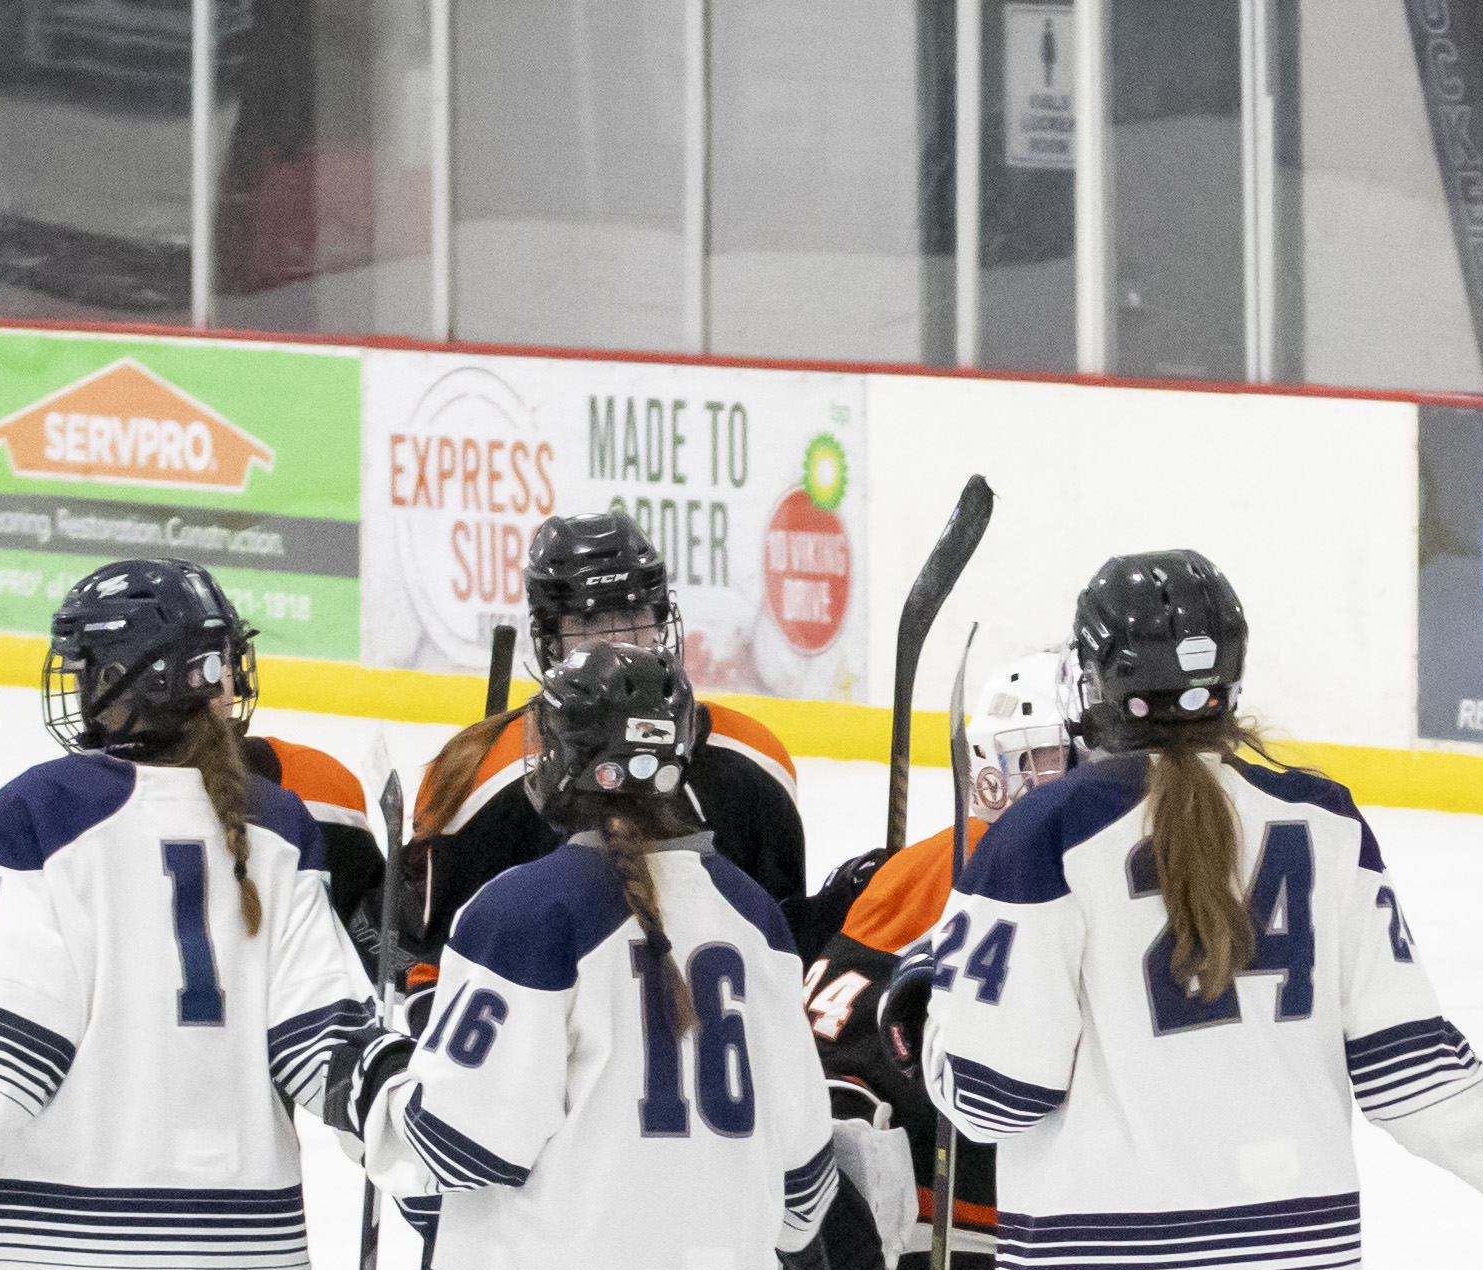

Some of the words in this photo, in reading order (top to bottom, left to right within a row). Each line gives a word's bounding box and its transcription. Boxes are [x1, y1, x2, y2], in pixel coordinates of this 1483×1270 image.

[43, 412, 213, 471] SERVPRO
[389, 434, 556, 515] EXPRESS
[589, 395, 688, 486] MADE
[706, 400, 750, 488] TO
[452, 520, 538, 605] SUB
[586, 572, 630, 586] CCM
[161, 840, 227, 1028] 1
[931, 908, 1019, 1007] 24
[1124, 819, 1318, 1038] 24
[422, 979, 510, 1069] 16
[629, 938, 757, 1140] 16
